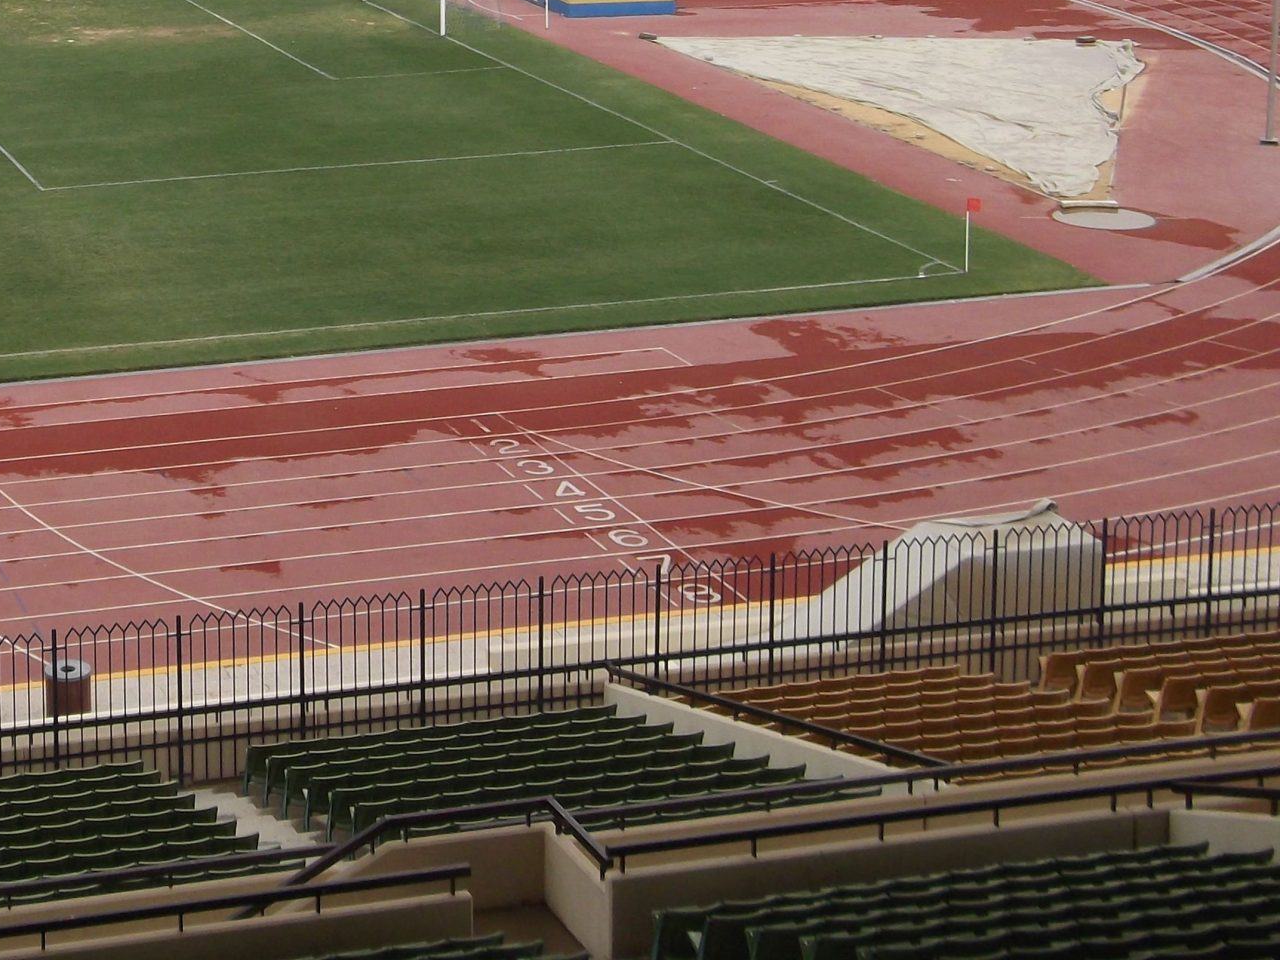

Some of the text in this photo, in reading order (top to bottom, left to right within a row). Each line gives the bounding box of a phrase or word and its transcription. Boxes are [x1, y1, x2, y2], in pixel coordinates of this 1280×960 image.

[470, 419, 491, 433] 1
[489, 439, 529, 454] 2
[516, 460, 554, 475] 3
[555, 480, 586, 497] 4
[574, 503, 615, 521] 5
[608, 529, 648, 547] 6
[636, 554, 670, 574] 7
[677, 583, 721, 604] 8
